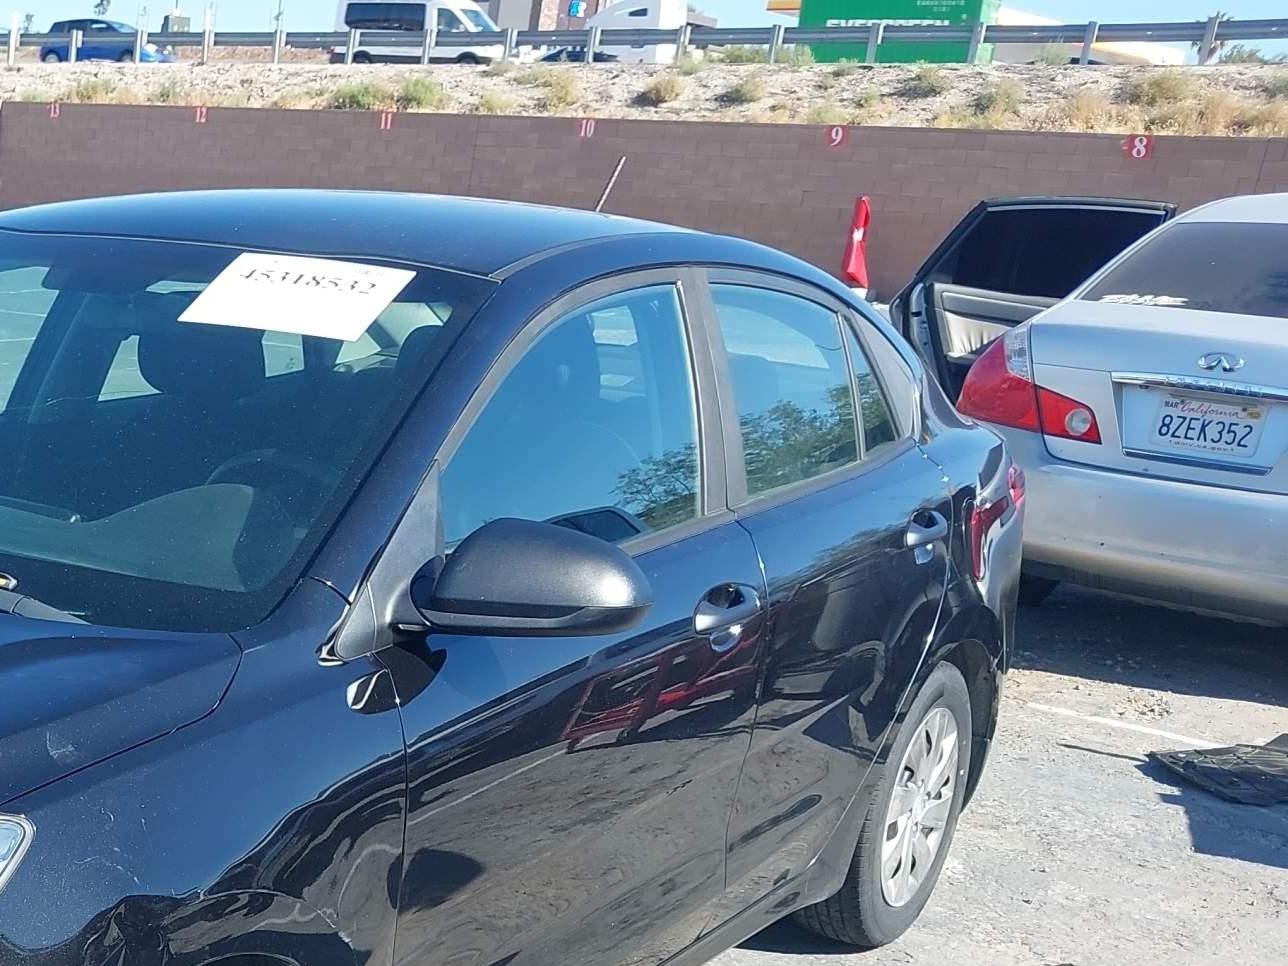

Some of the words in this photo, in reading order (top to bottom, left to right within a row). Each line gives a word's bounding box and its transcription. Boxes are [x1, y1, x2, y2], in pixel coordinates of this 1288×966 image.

[826, 19, 950, 27] EVEGREEN
[50, 103, 61, 118] 13
[195, 107, 208, 123] 12
[380, 112, 393, 129] 11
[579, 119, 596, 137] 10
[829, 126, 844, 146] 9
[1131, 136, 1148, 158] 8
[240, 269, 376, 295] 45318532
[1164, 400, 1180, 409] MAR
[1180, 401, 1245, 419] California
[1158, 414, 1254, 449] 8ZEK352
